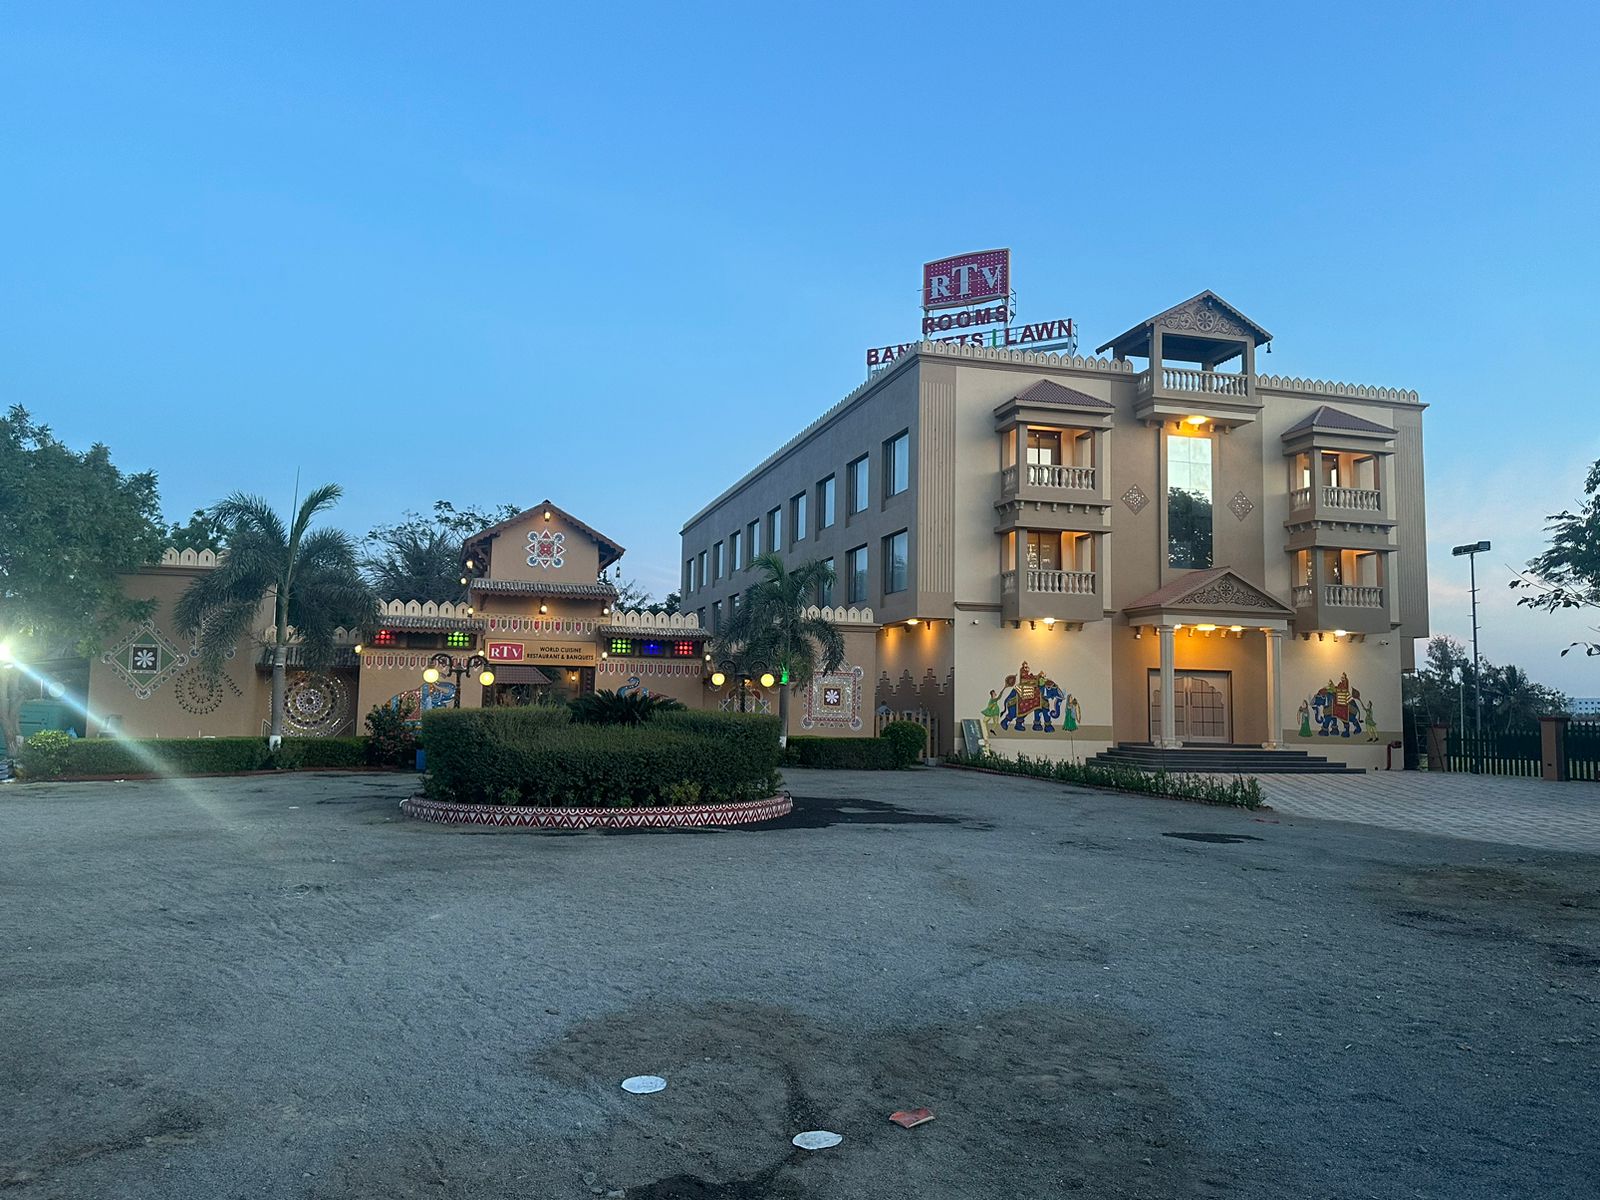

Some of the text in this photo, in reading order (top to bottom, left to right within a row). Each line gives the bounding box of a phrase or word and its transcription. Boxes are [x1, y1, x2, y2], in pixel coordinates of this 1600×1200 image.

[929, 264, 1002, 299] RTV
[922, 305, 1008, 334] ROOMS
[1004, 319, 1072, 345] LAWN
[491, 645, 521, 658] RTV
